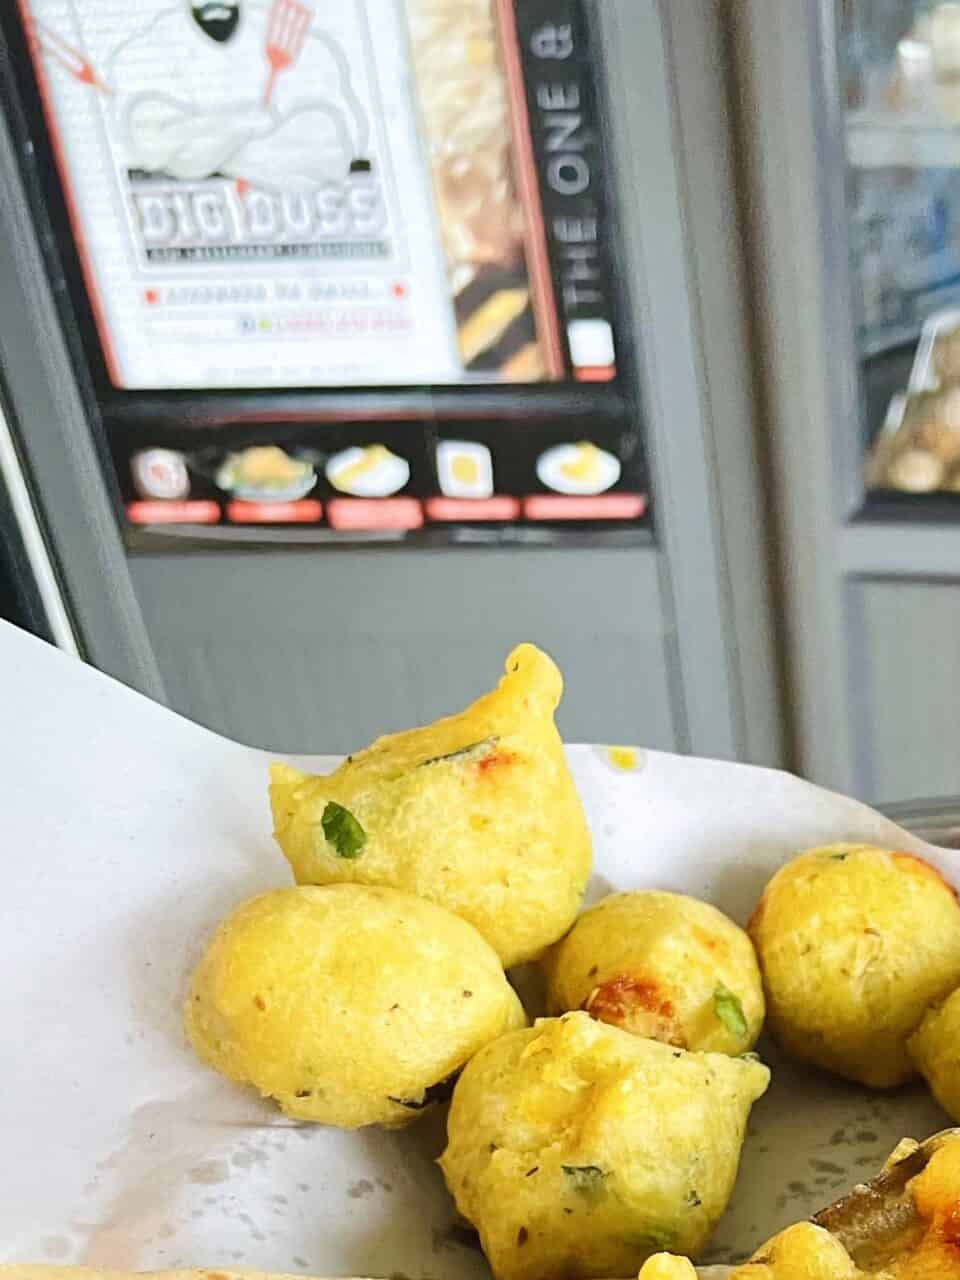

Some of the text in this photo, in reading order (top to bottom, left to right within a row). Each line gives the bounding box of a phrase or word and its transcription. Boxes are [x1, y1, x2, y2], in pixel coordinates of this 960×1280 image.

[529, 22, 604, 305] THE ONE &
